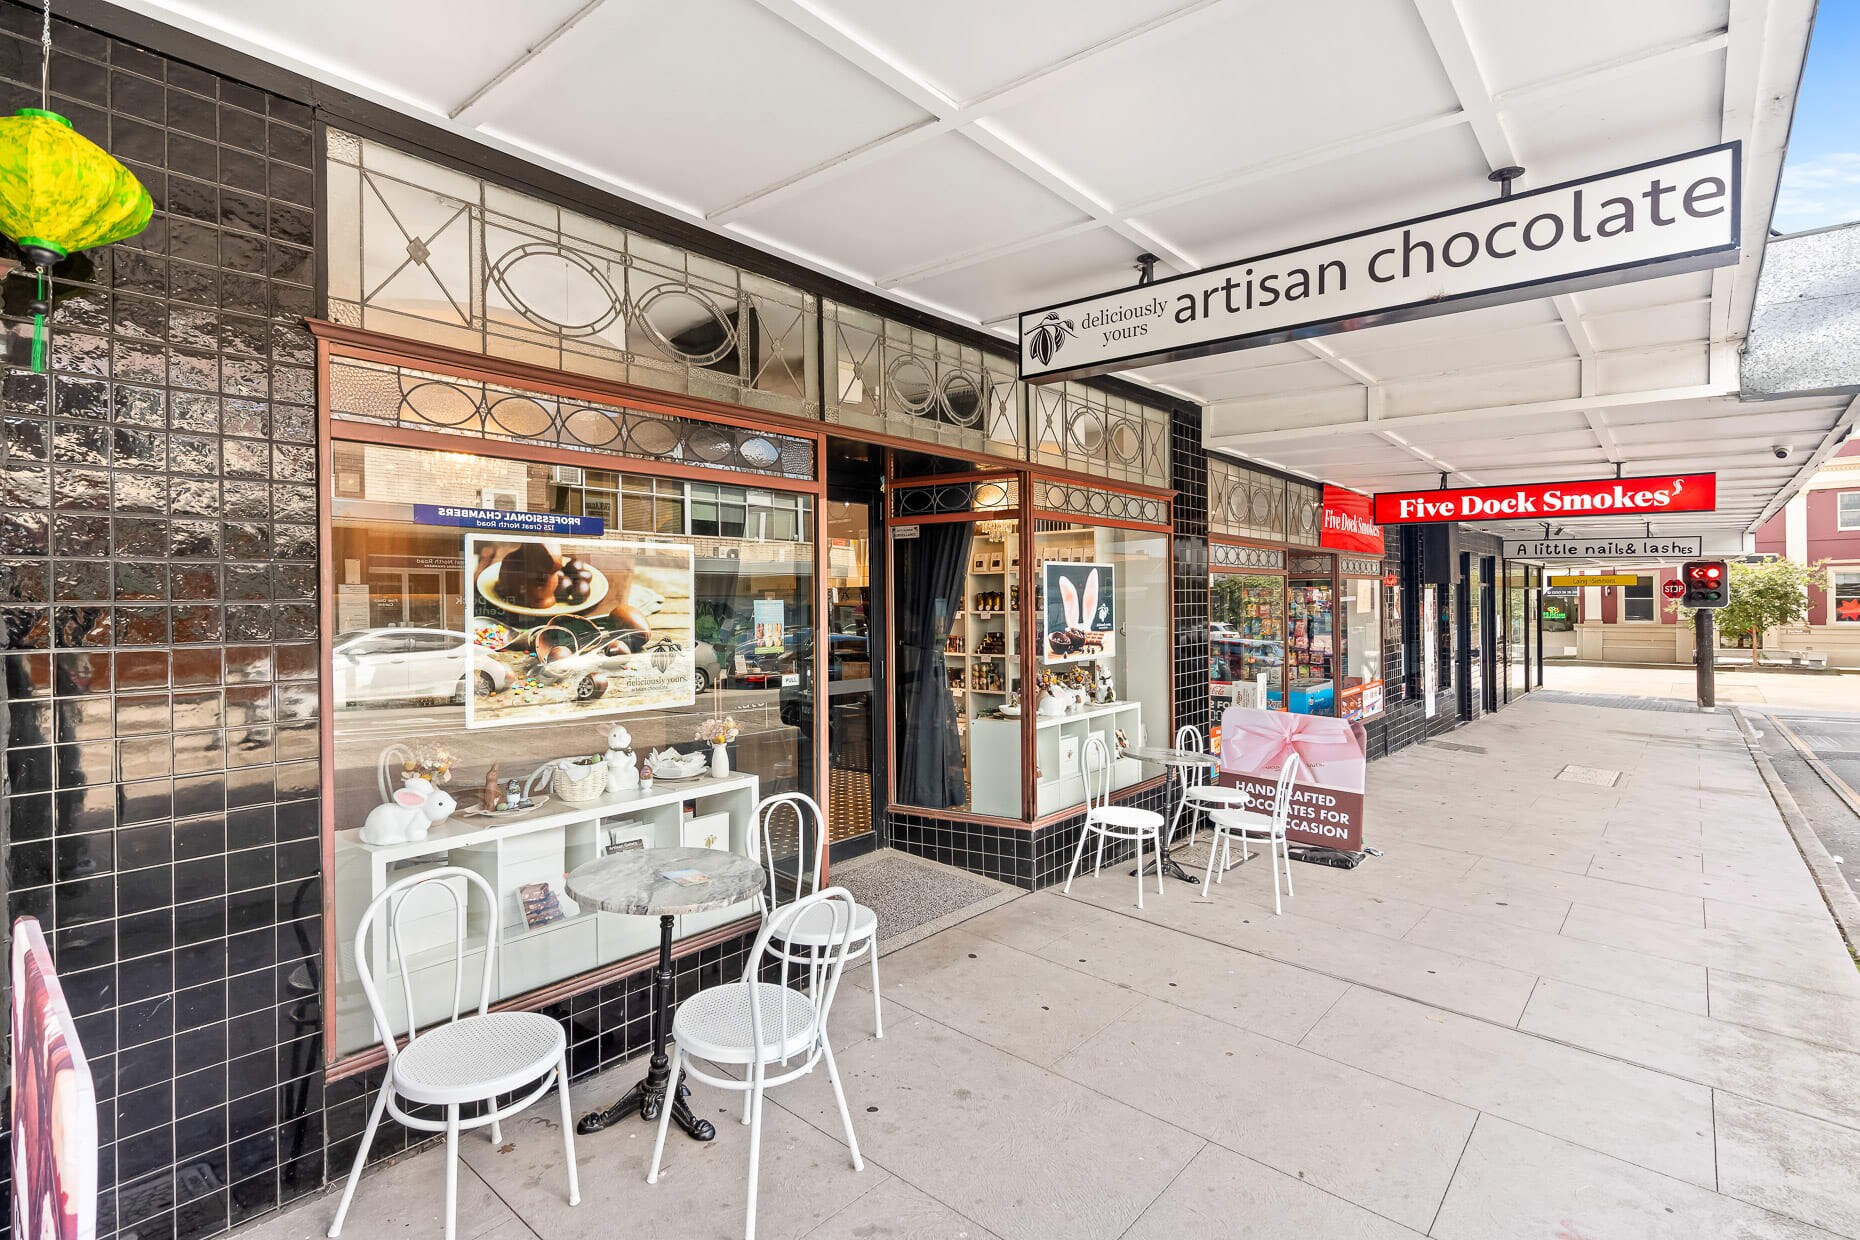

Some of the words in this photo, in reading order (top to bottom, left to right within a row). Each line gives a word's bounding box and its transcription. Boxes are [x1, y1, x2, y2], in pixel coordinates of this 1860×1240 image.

[1174, 258, 1347, 324] artisan
[1368, 176, 1726, 283] chocolate
[1081, 297, 1168, 330] deliciously
[1102, 323, 1148, 347] yours
[1399, 497, 1454, 519] Five
[1461, 491, 1537, 516] Dock
[1542, 485, 1670, 512] Smokes
[1324, 509, 1341, 530] Five
[1341, 512, 1358, 534] Dock
[1358, 517, 1380, 537] Smokes
[1517, 543, 1527, 556] A
[1534, 542, 1578, 556] little
[1664, 585, 1684, 593] STOP
[626, 676, 666, 687] deliciously
[1320, 809, 1350, 825] FOR
